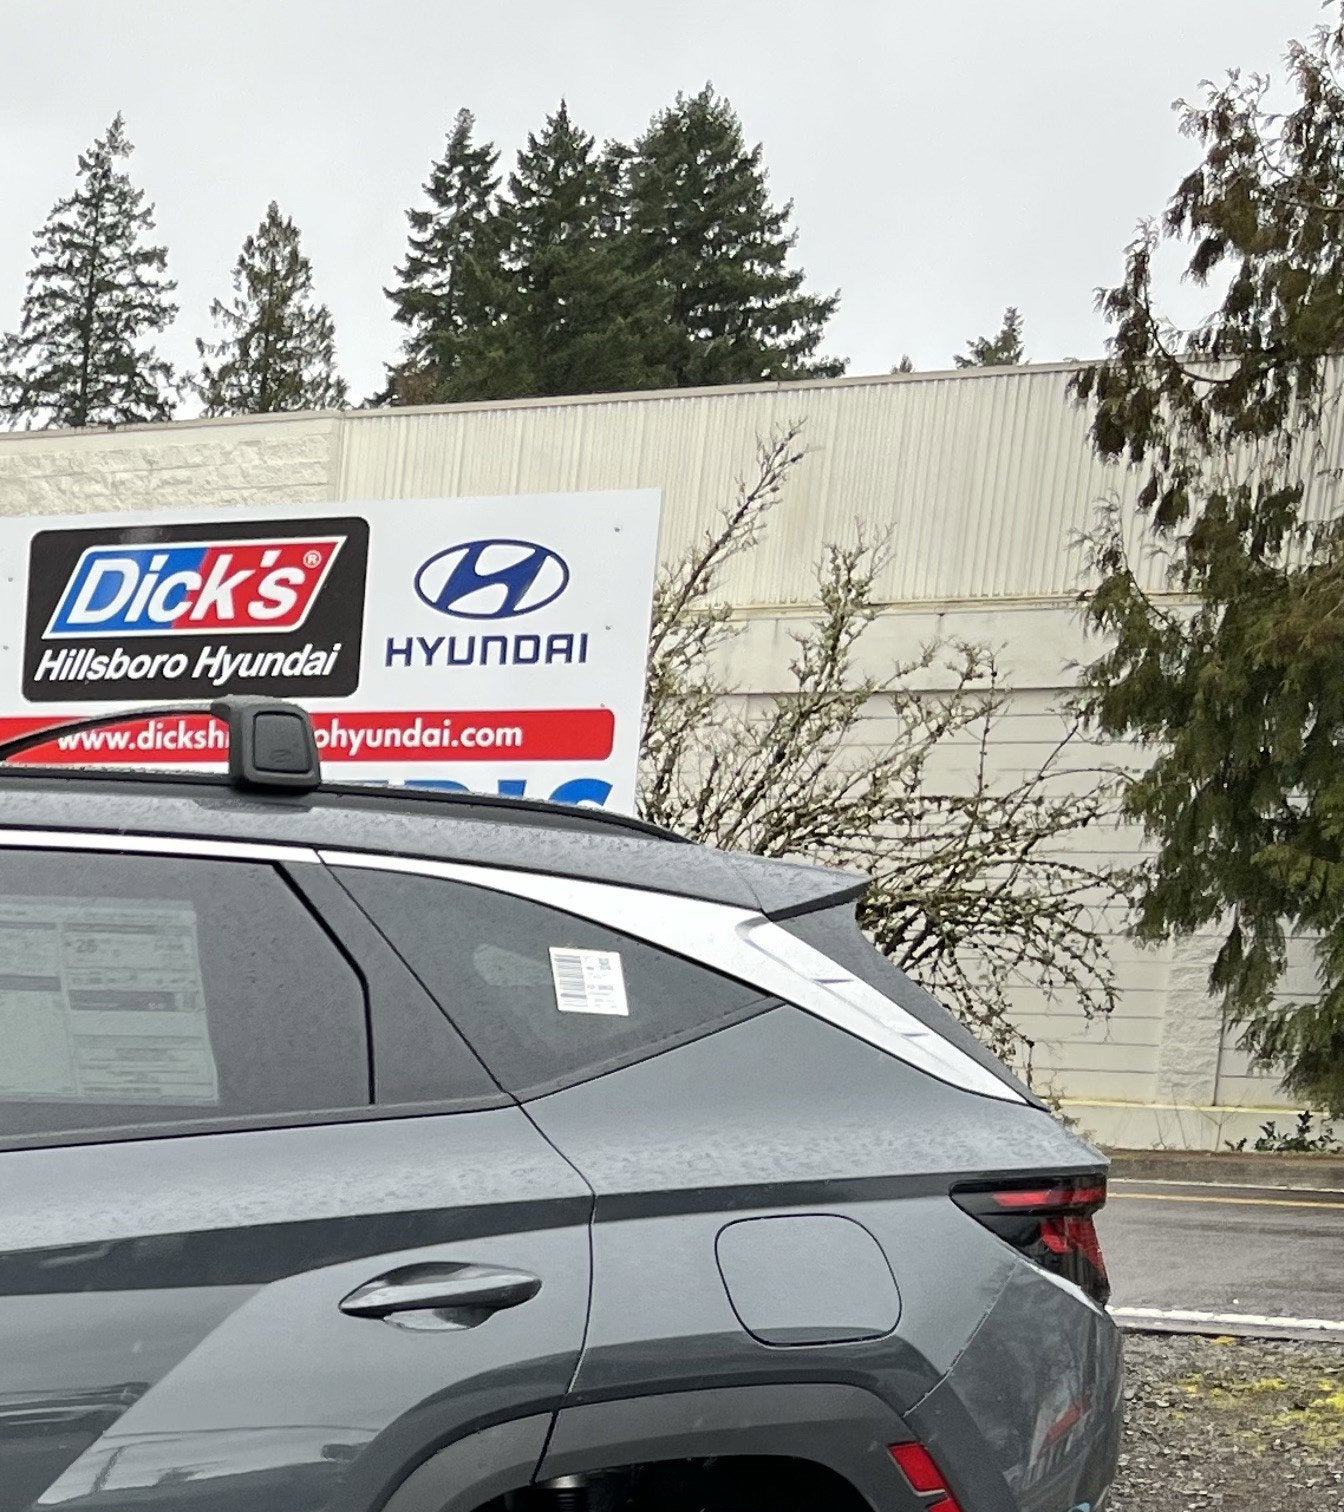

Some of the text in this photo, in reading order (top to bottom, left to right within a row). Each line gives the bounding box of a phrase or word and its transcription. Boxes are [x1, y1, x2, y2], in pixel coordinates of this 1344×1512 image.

[65, 549, 306, 625] Dick's
[32, 642, 342, 687] Hillsboro Hyundai
[385, 632, 589, 667] HYUNDAI
